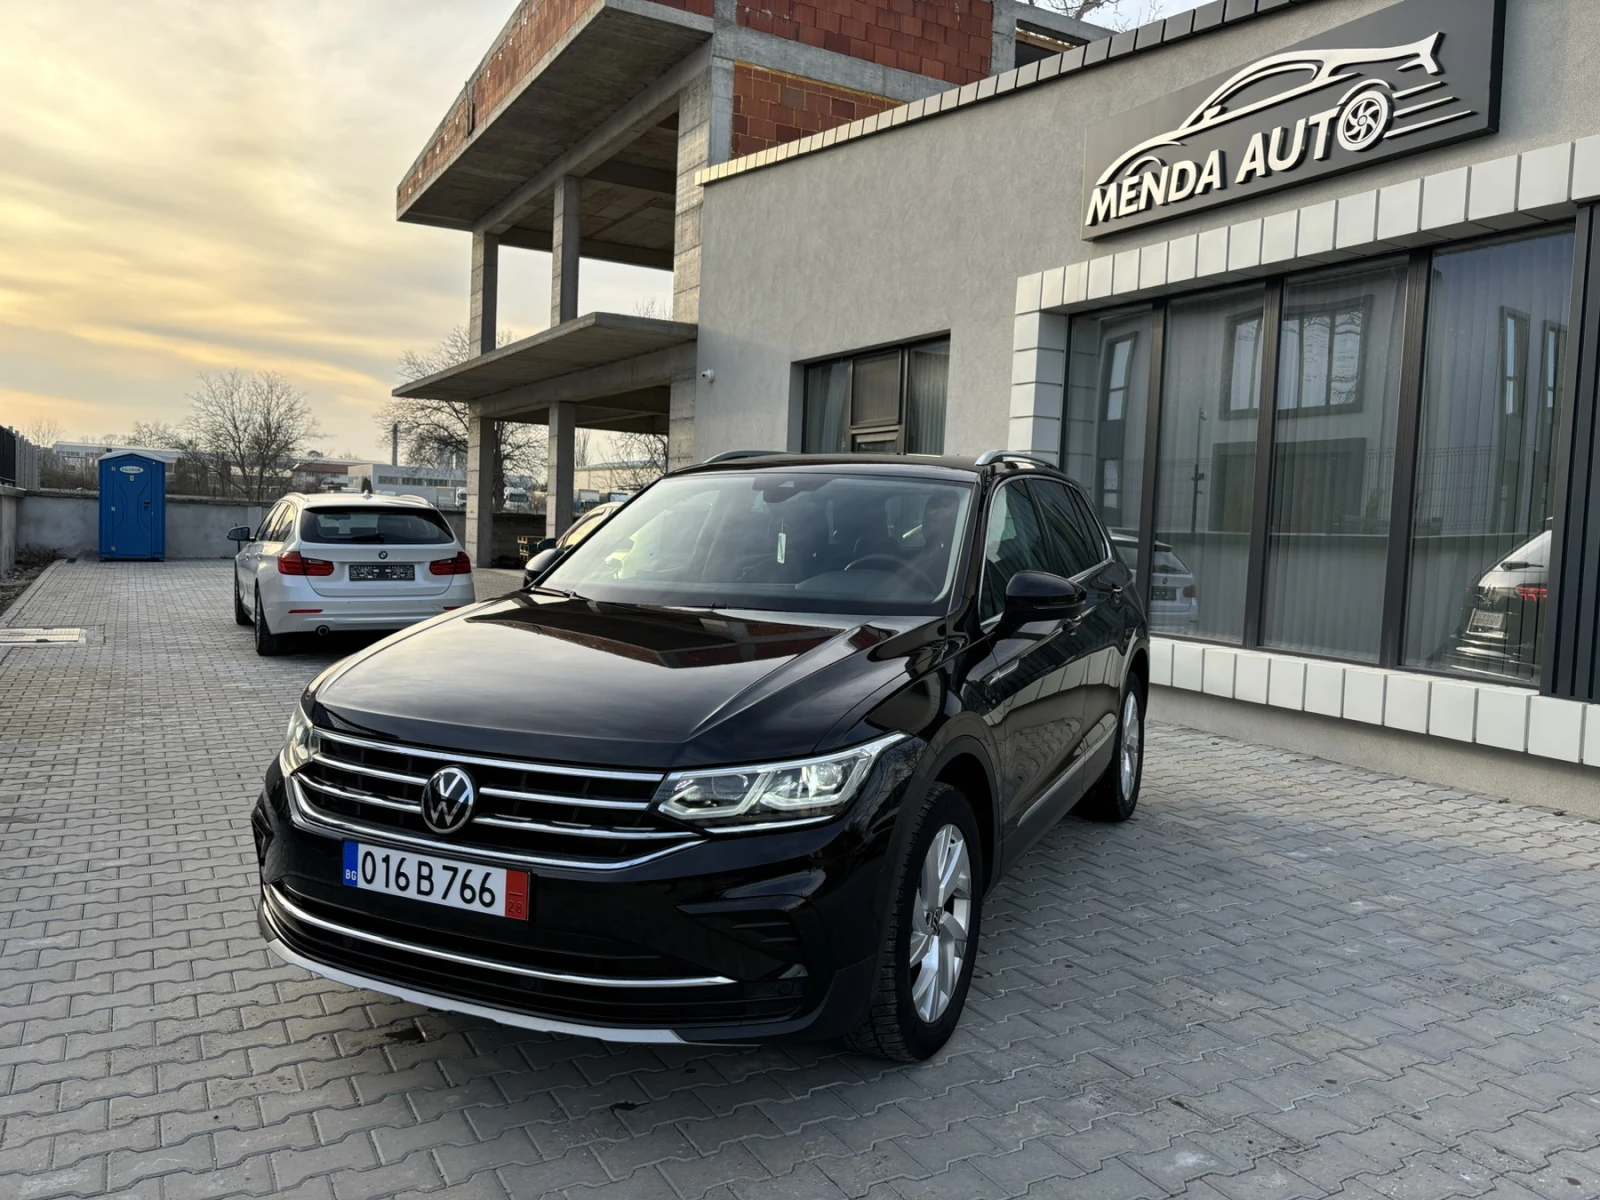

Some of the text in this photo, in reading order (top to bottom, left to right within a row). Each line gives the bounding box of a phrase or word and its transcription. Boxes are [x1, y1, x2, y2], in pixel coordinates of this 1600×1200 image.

[1085, 149, 1226, 226] MENDA
[345, 869, 357, 881] BG
[508, 900, 523, 914] 28
